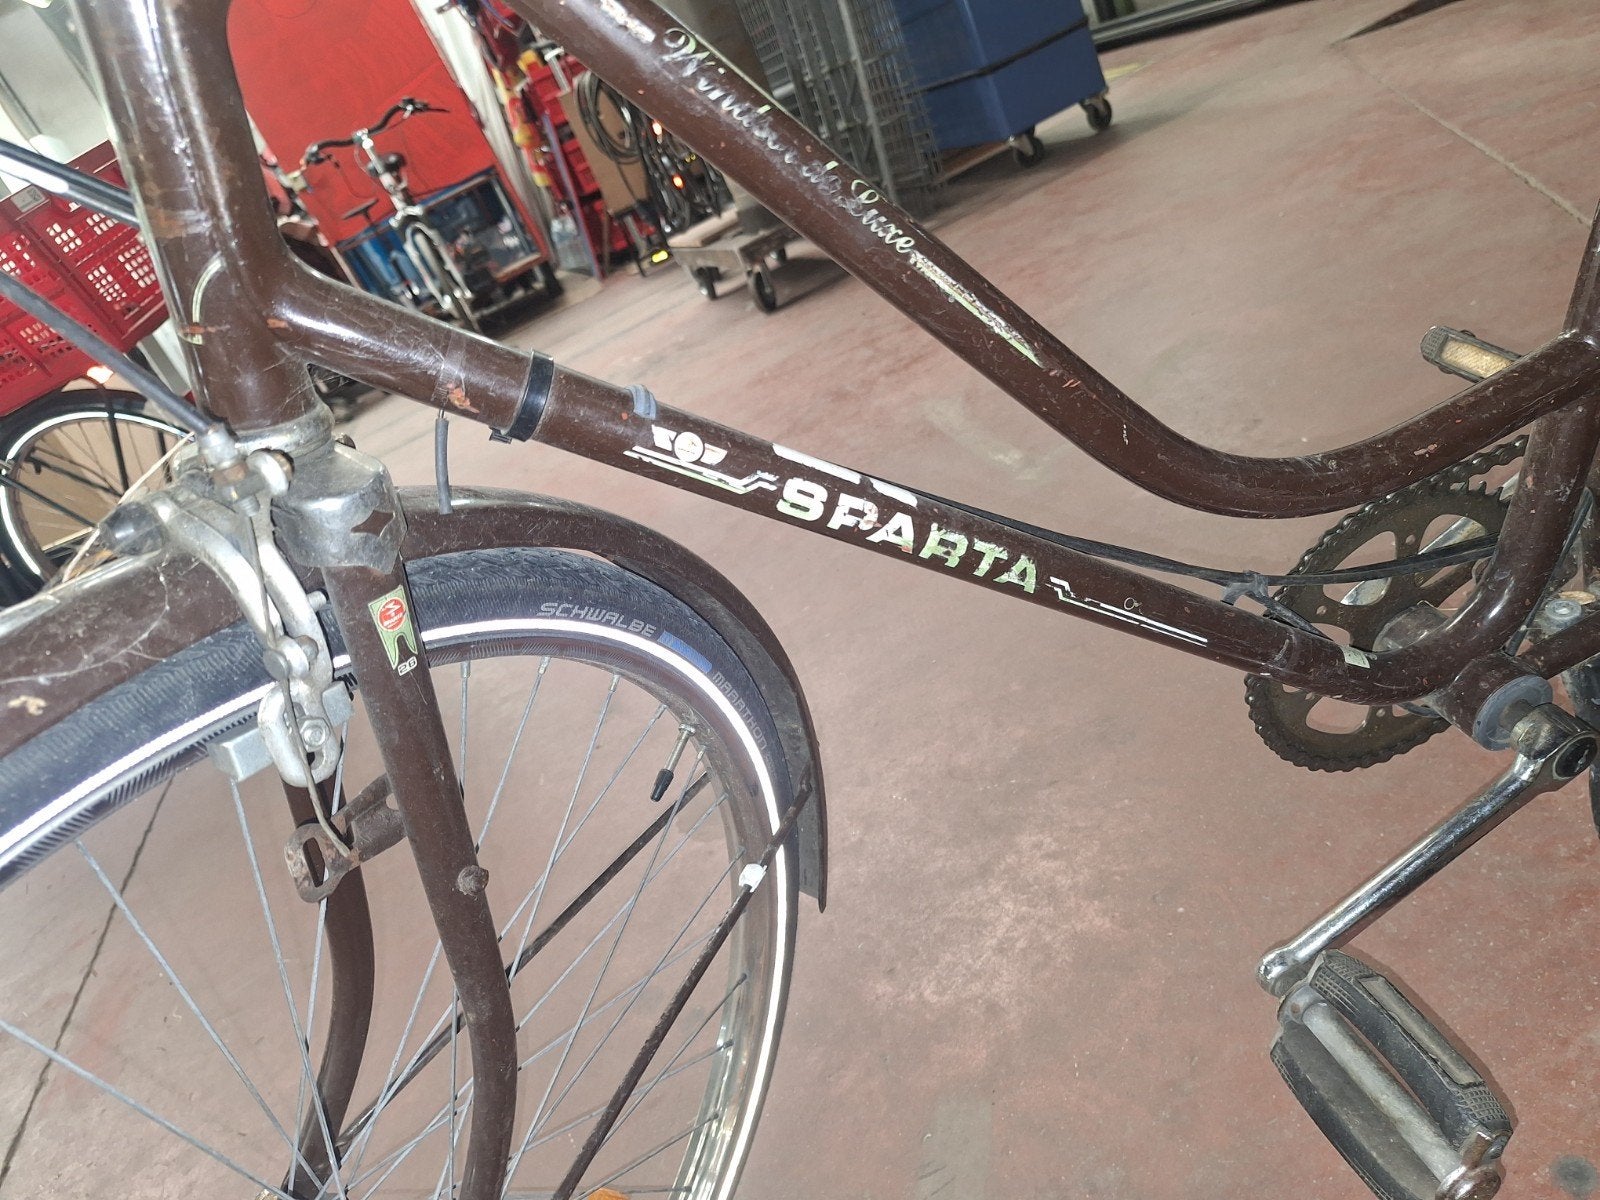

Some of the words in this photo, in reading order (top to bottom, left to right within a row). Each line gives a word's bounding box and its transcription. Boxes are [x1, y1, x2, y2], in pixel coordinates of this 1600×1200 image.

[839, 179, 915, 253] Luxe
[776, 477, 1038, 594] SPARTA
[537, 602, 657, 637] SCHWALBE
[712, 671, 768, 751] MARATHON
